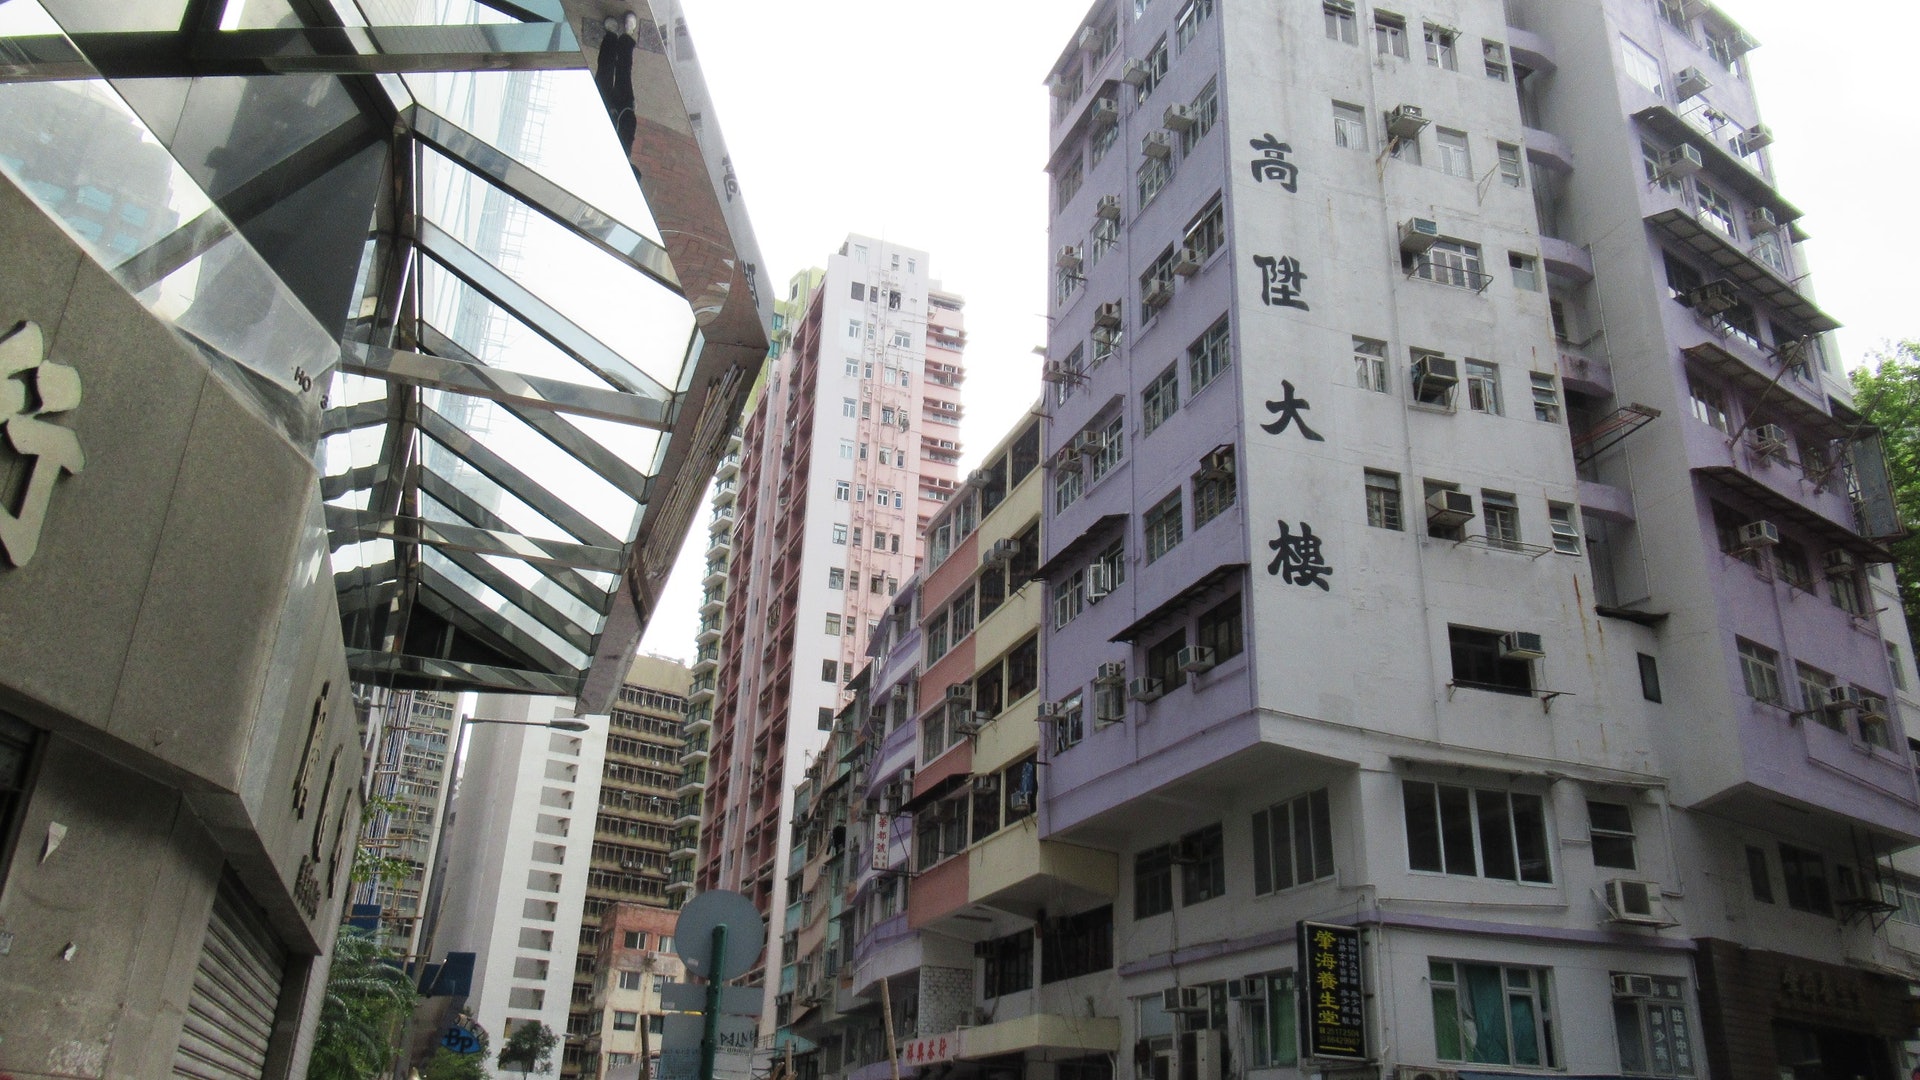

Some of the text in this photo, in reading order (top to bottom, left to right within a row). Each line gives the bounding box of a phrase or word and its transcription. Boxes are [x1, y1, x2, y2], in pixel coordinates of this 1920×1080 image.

[1250, 133, 1333, 592] 高陞大樓
[1314, 930, 1340, 1025] 肇海養生堂
